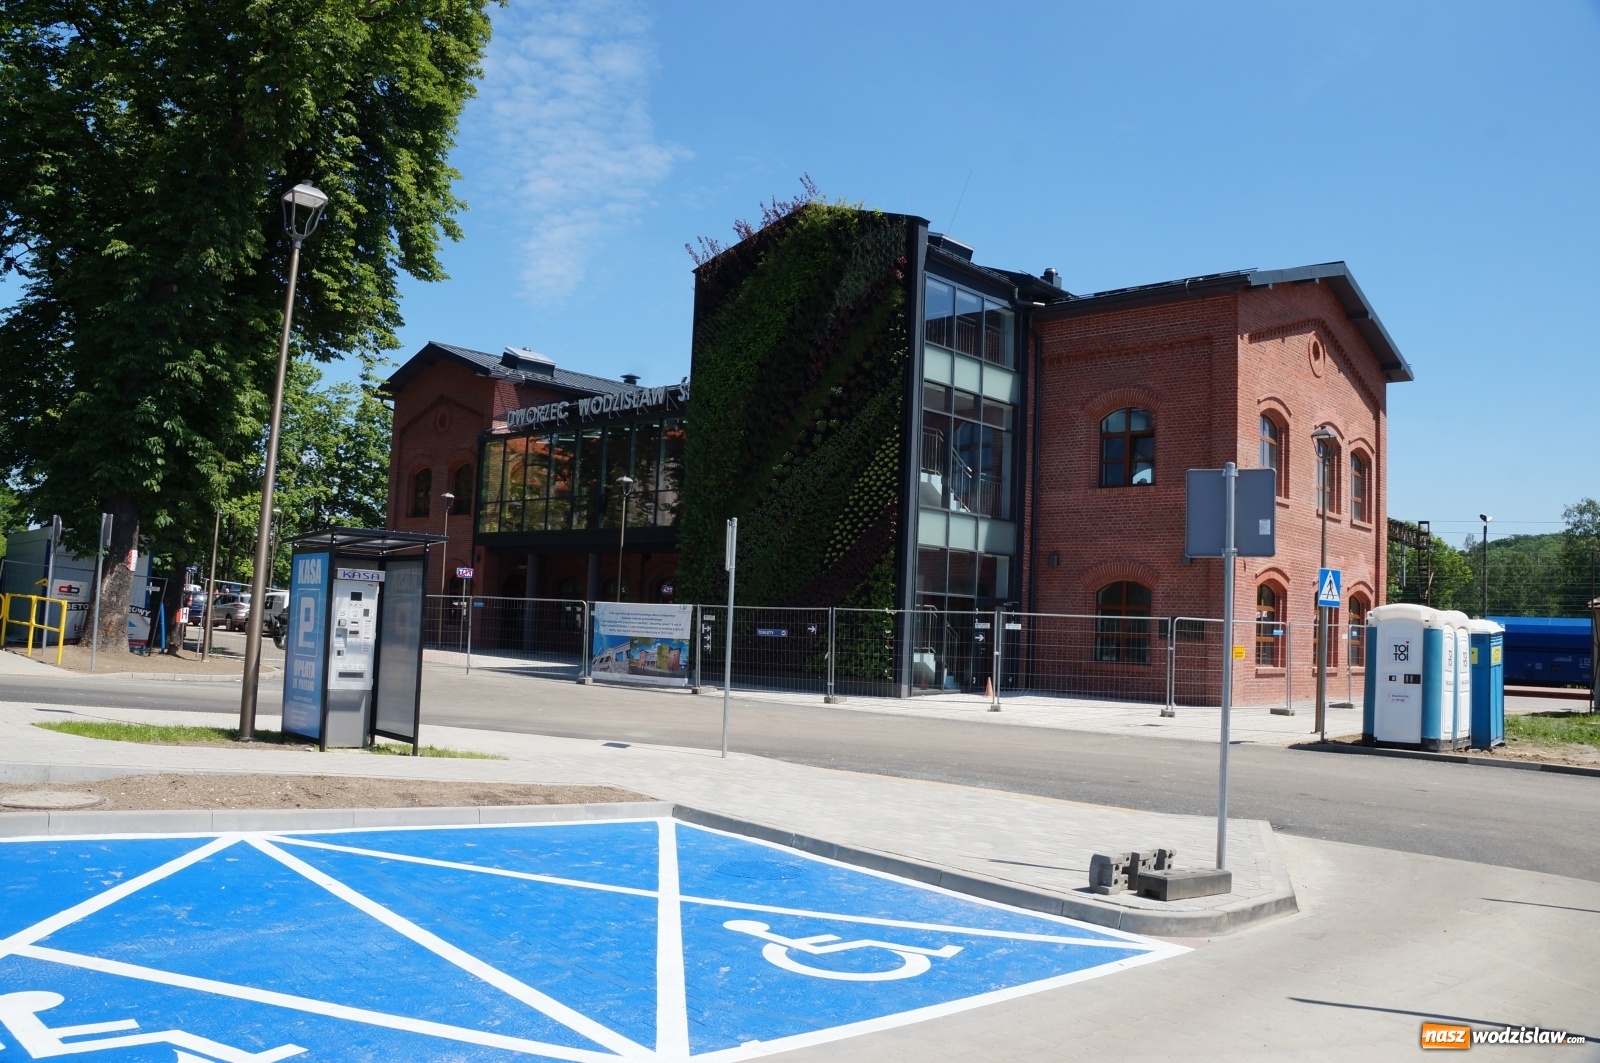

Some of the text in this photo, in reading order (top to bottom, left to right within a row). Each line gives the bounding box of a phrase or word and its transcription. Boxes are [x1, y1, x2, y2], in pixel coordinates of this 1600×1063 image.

[507, 401, 570, 429] DWORZEC
[578, 386, 667, 416] WODZISŁAW
[298, 558, 321, 585] KASA
[343, 570, 380, 580] KASA
[458, 569, 473, 577] TAXI
[1393, 652, 1409, 662] TOI
[293, 658, 315, 679] OPŁATA
